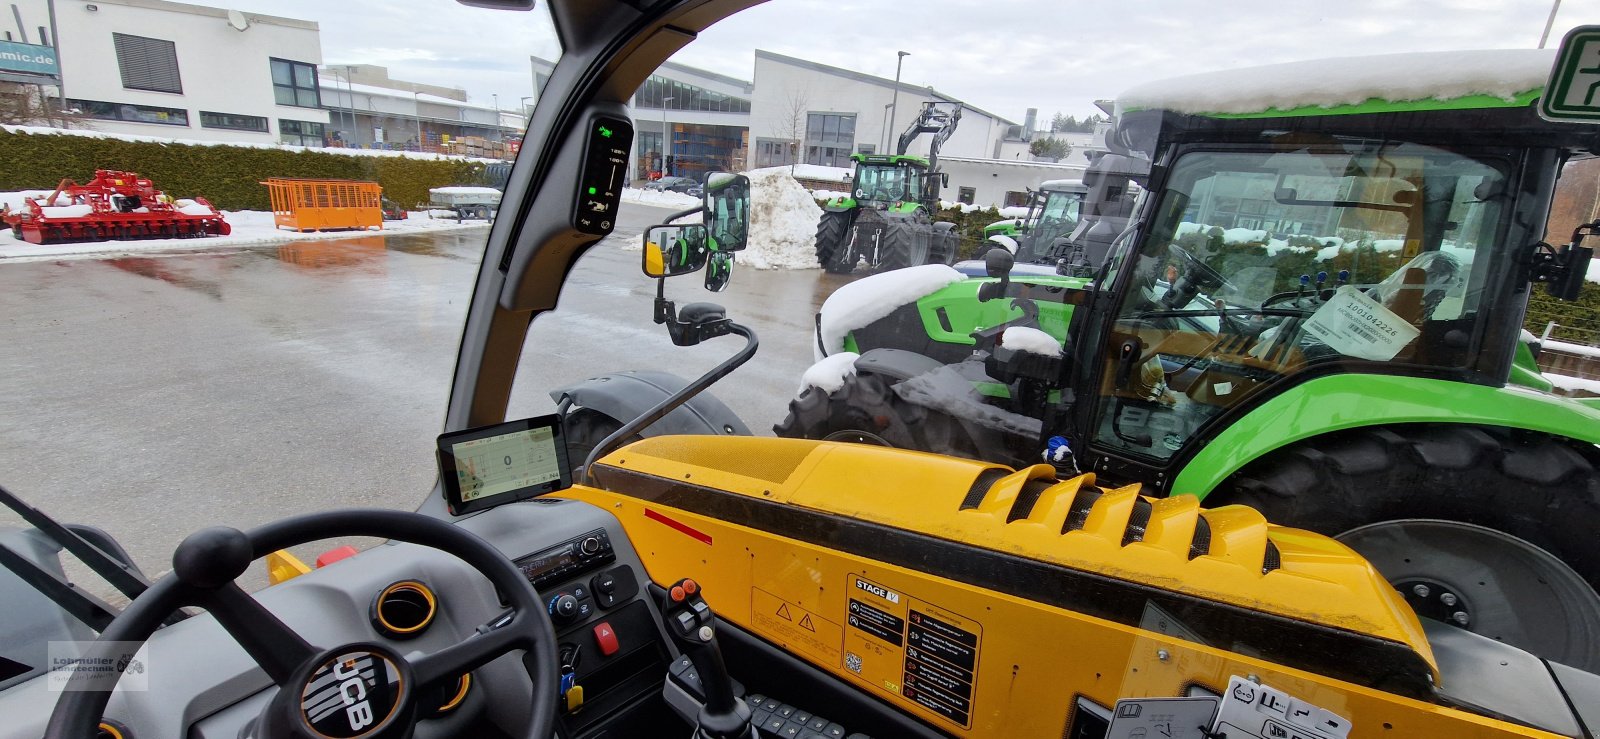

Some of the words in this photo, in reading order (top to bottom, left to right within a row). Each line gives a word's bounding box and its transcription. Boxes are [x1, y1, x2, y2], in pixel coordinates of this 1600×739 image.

[1346, 302, 1398, 337] 1001042226
[503, 455, 512, 466] 0
[857, 580, 886, 598] STAGE
[333, 662, 374, 731] JCB
